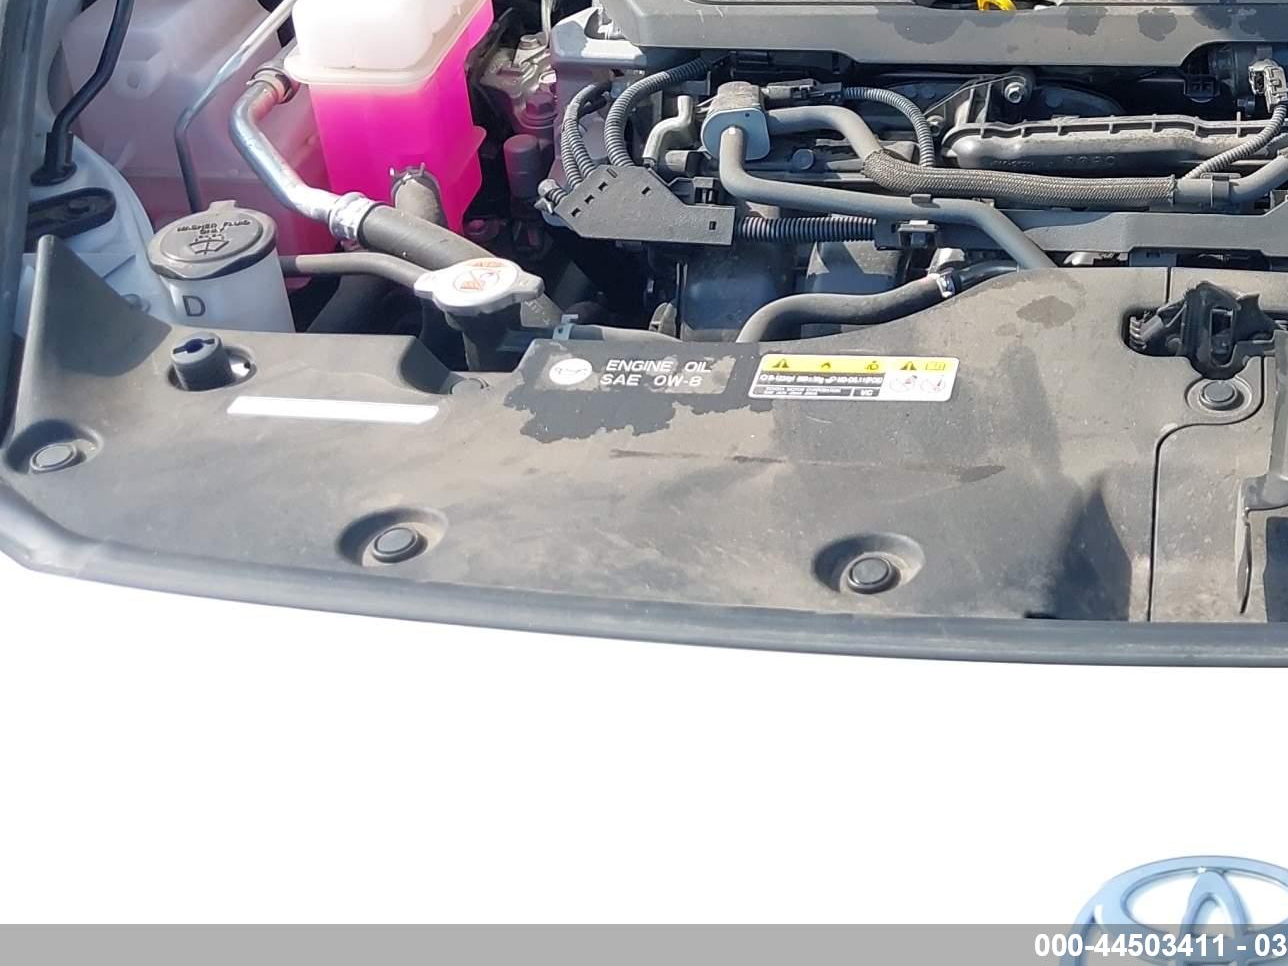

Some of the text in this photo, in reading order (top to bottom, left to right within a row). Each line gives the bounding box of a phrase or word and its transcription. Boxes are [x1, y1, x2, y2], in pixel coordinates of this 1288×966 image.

[182, 295, 206, 317] D
[605, 359, 713, 373] ENGINE OIL
[600, 373, 703, 387] SAE 0W-8
